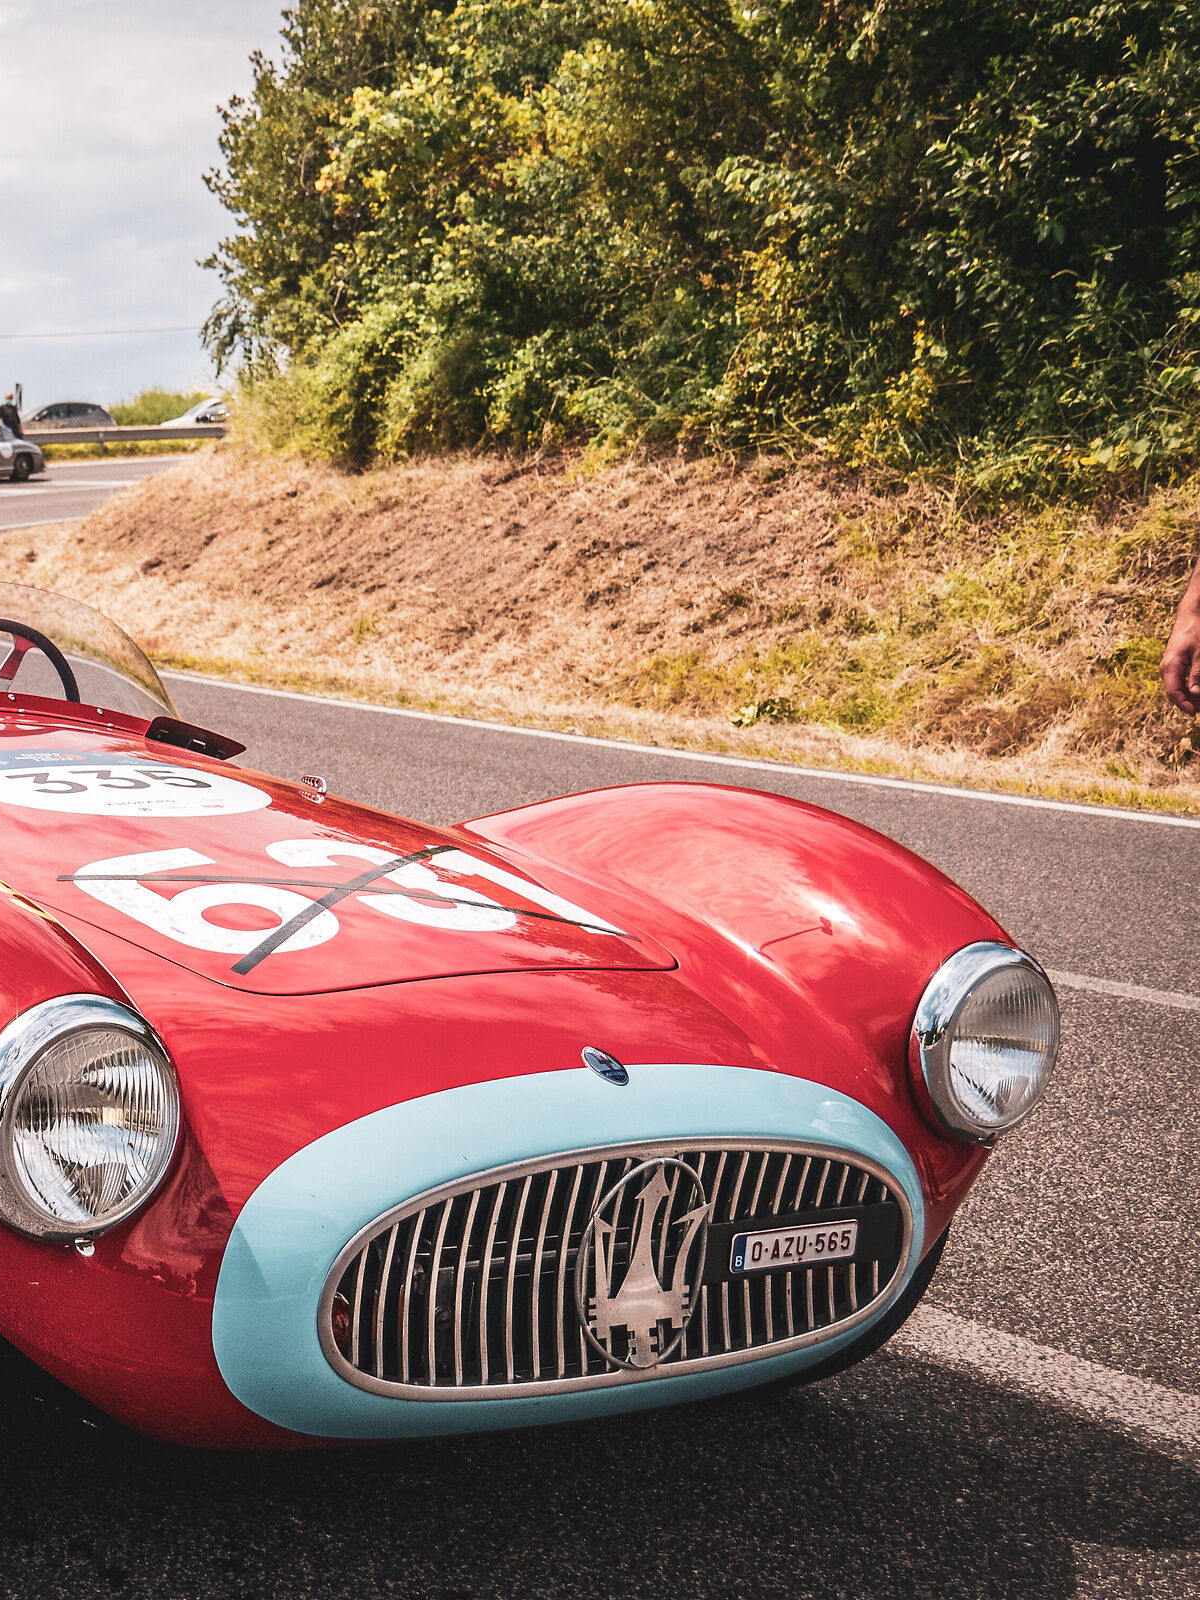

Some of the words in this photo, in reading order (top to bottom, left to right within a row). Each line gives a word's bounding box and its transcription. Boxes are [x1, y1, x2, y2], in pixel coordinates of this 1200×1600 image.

[5, 769, 212, 794] 335
[73, 838, 628, 954] 631
[735, 1256, 743, 1267] B
